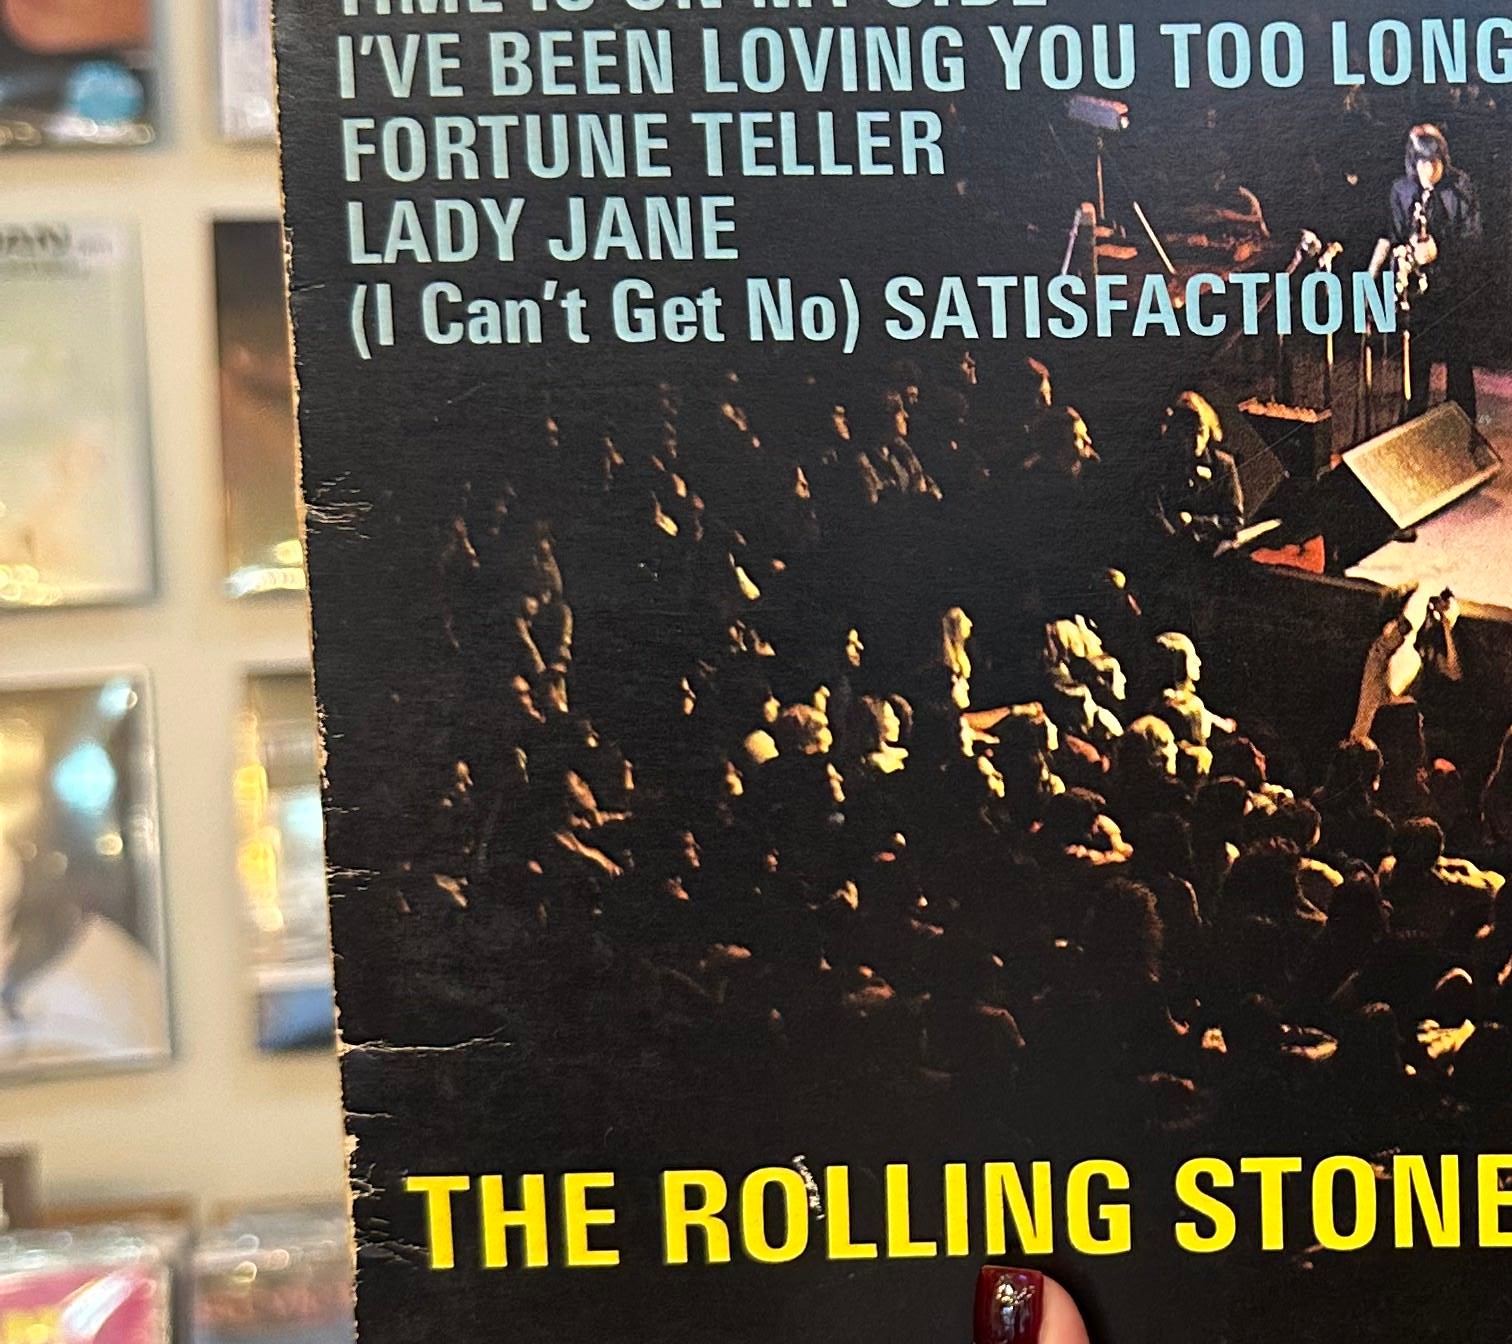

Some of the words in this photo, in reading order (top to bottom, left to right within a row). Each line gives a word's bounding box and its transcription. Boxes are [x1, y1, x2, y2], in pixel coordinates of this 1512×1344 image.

[337, 33, 464, 99] I'VE
[488, 29, 674, 97] BEEN
[702, 25, 965, 93] LOVING
[987, 23, 1136, 91] YOU
[1159, 21, 1304, 89] TOO
[342, 113, 672, 182] FORTUNE
[690, 110, 946, 177] TELLER
[347, 198, 525, 265] LADY
[548, 196, 740, 262] JANE
[351, 283, 394, 360] (I
[420, 280, 590, 345] Can't
[612, 278, 725, 343] Get
[746, 277, 860, 354] No)
[884, 271, 1400, 341] SATISFACTION
[404, 1172, 621, 1270] THE
[663, 1159, 1132, 1265] ROLLING
